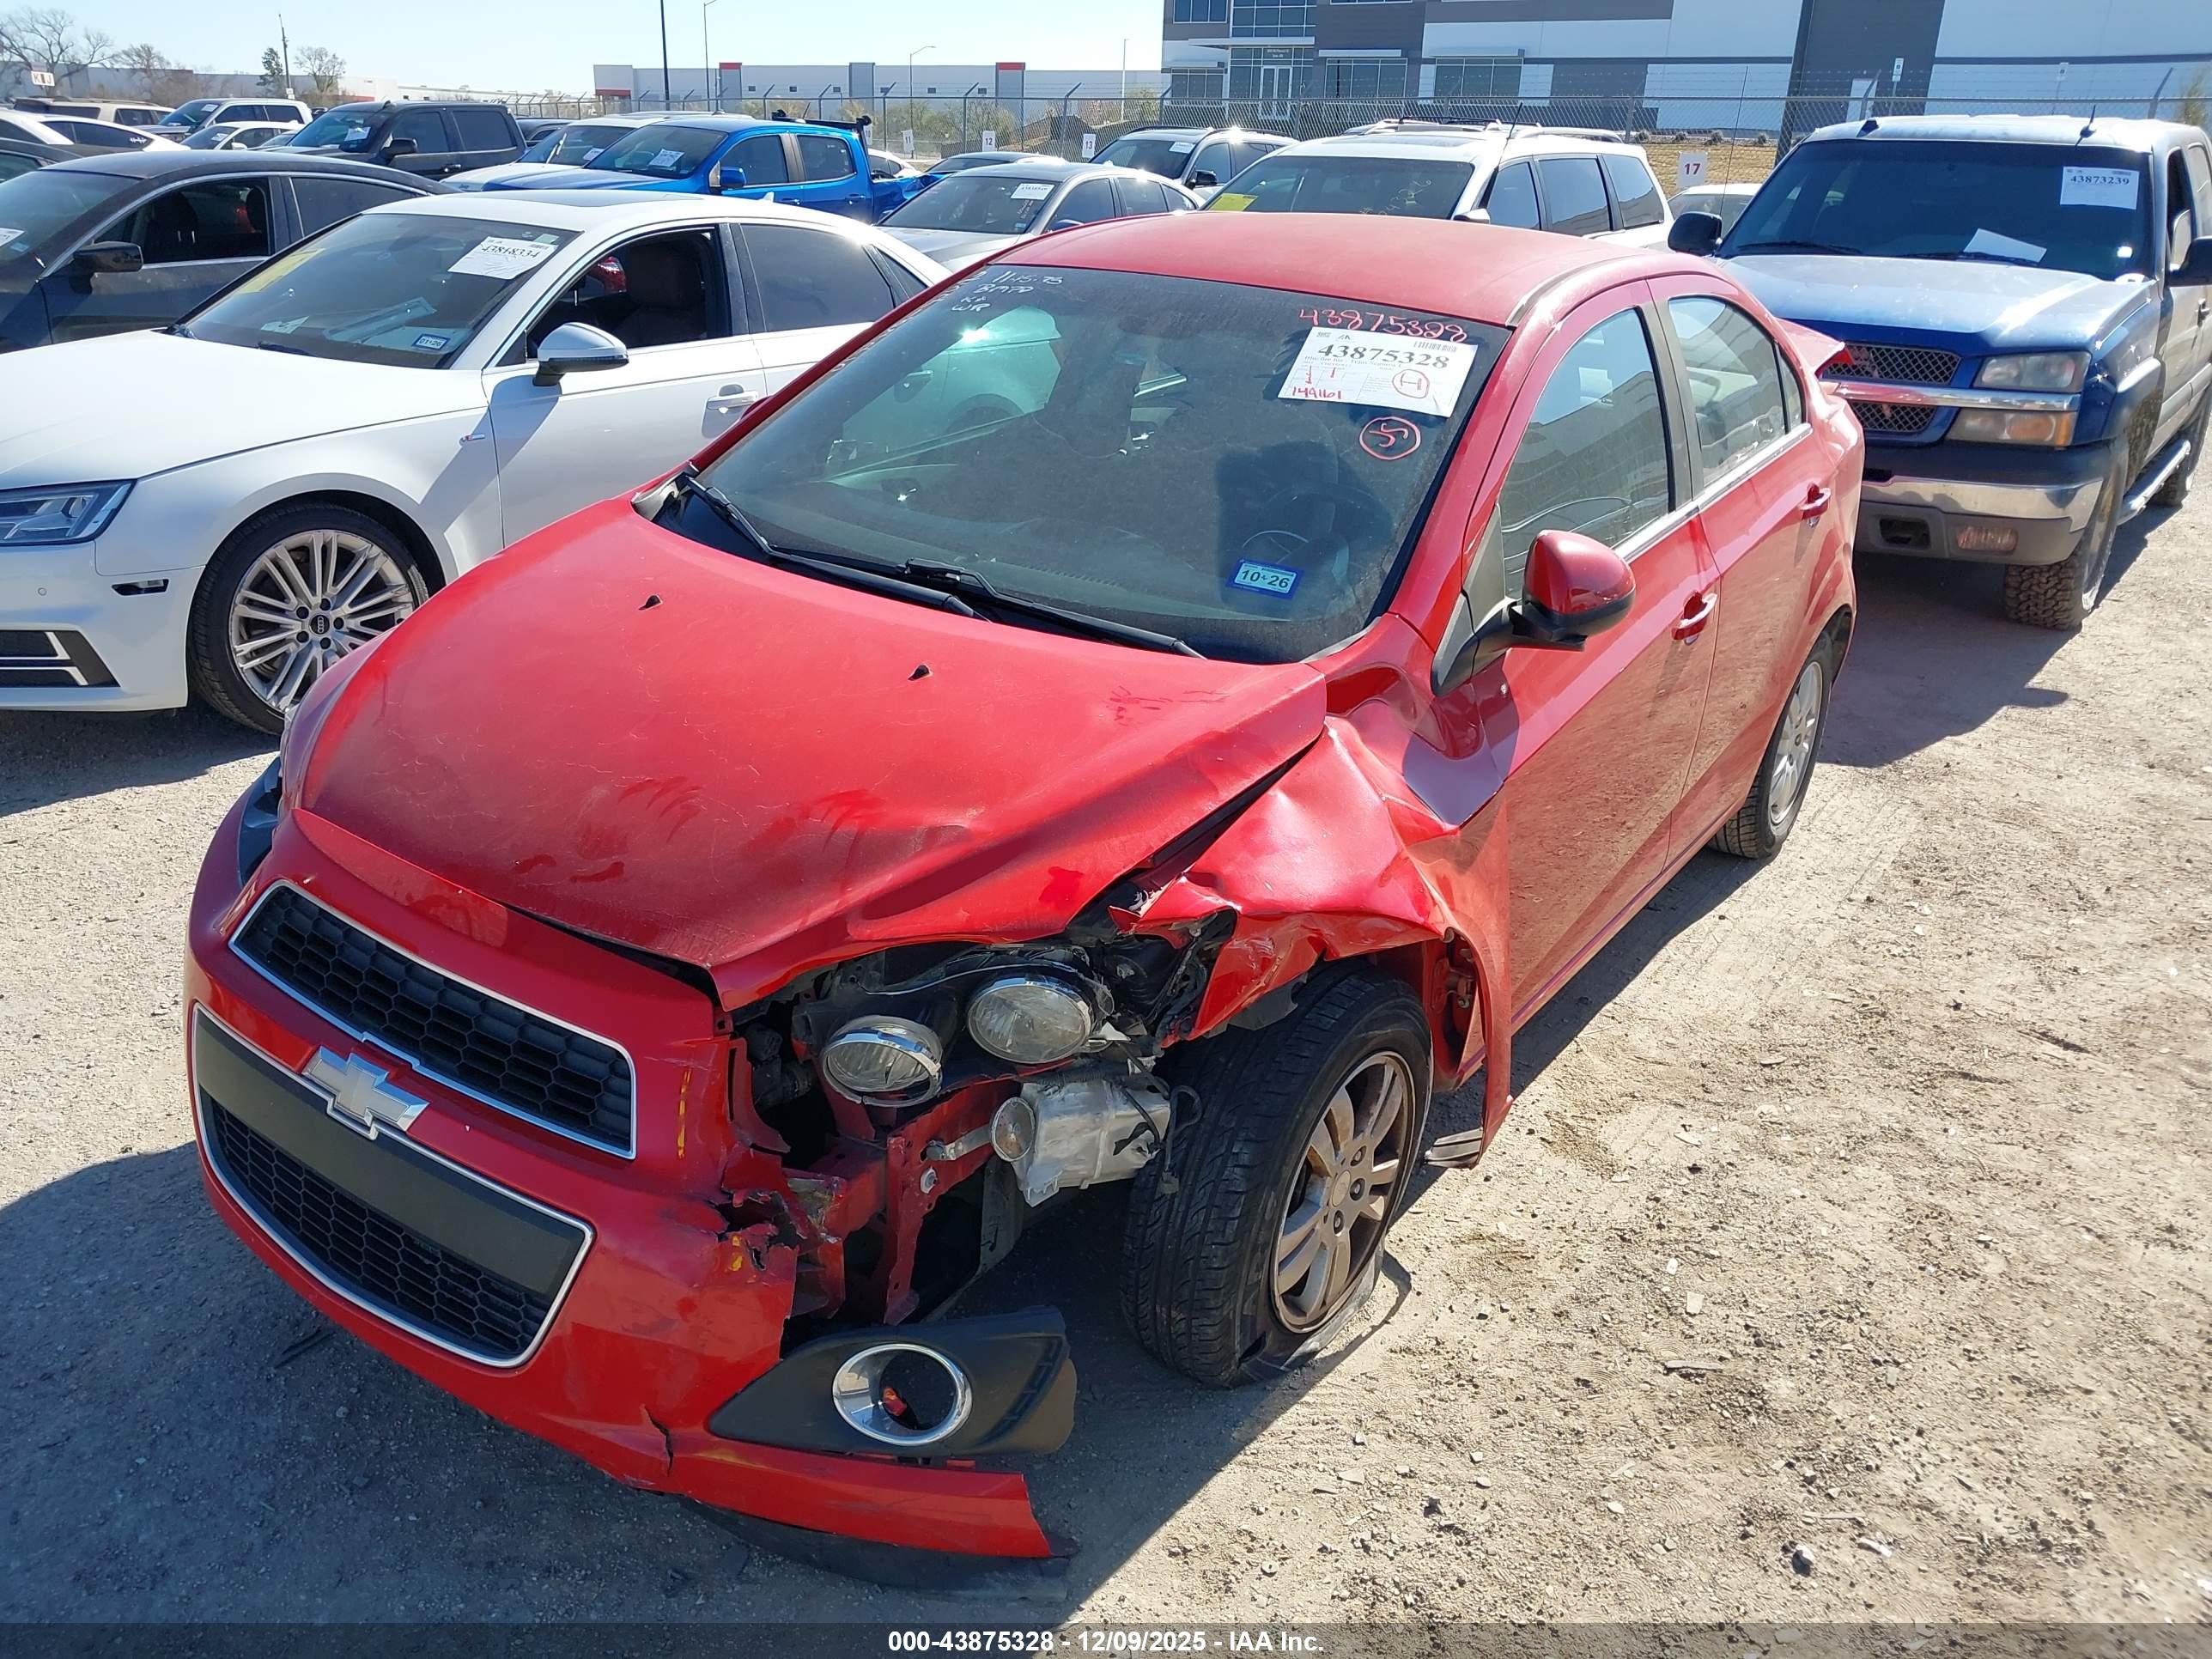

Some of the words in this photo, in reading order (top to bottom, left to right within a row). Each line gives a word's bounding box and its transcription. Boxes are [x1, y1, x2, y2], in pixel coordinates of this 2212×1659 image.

[985, 137, 993, 146] 12
[1085, 140, 1093, 150] 13
[1684, 162, 1701, 175] 17
[2069, 174, 2130, 185] 43873239
[1298, 308, 1468, 343] 43875328
[1317, 343, 1450, 369] 43875328
